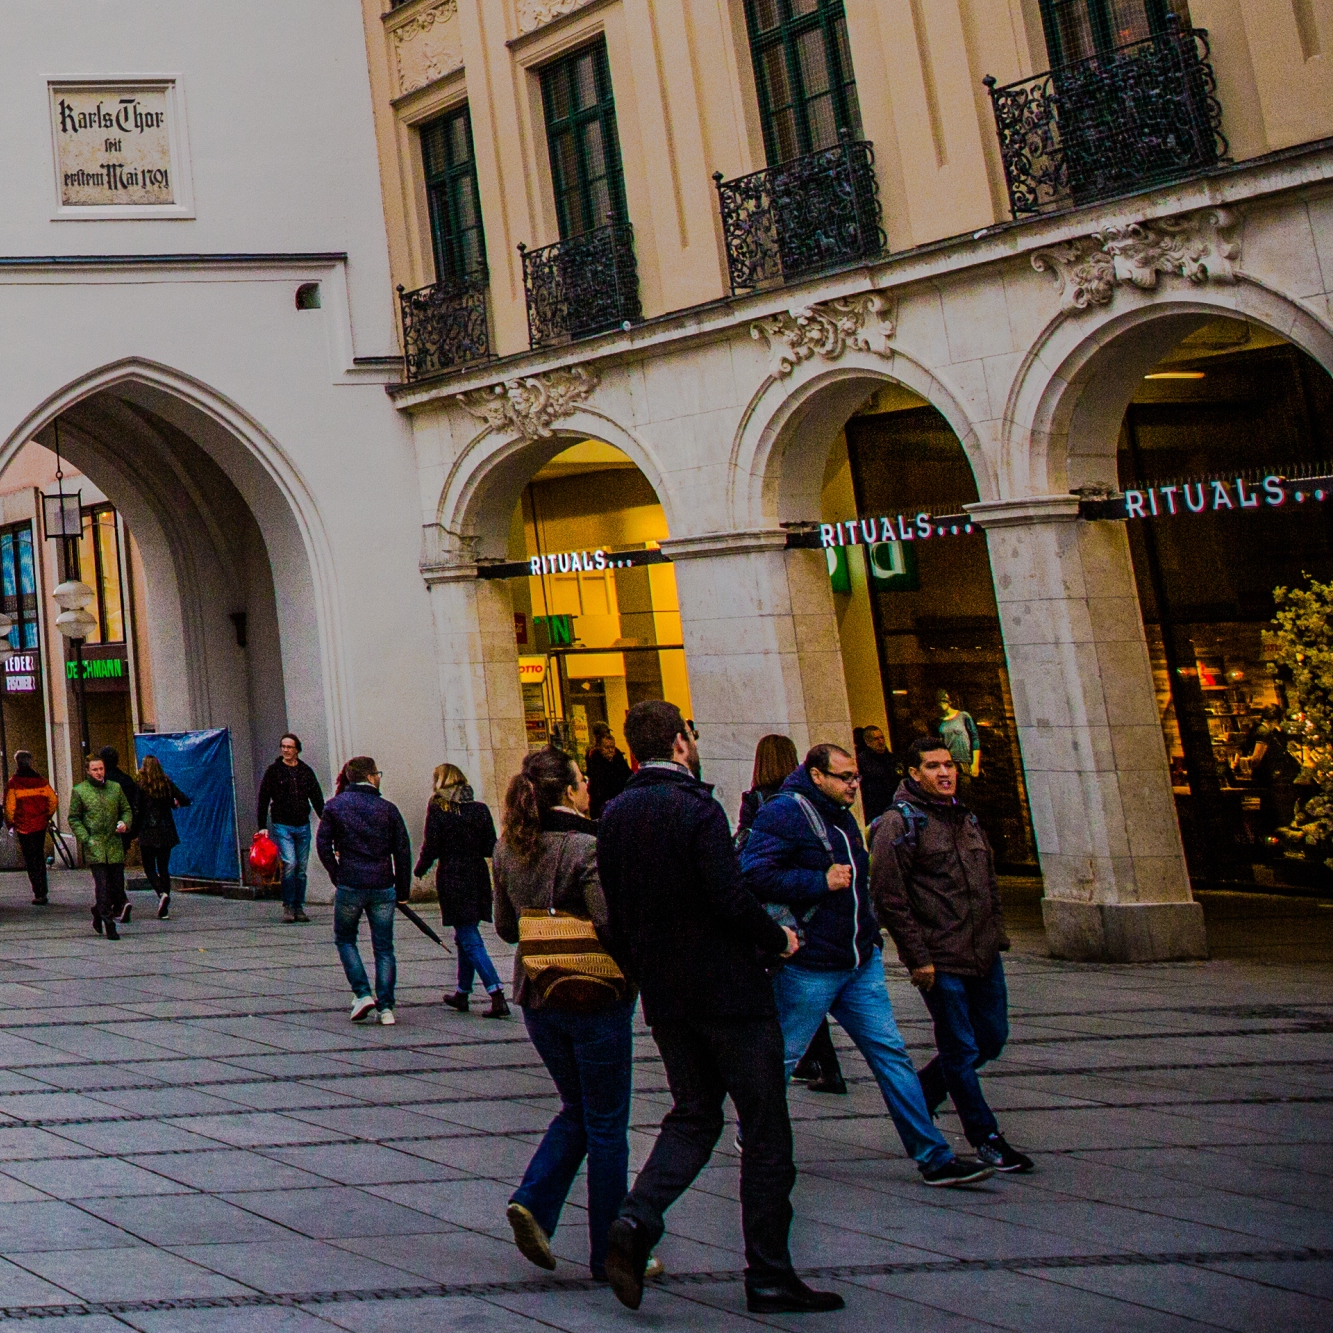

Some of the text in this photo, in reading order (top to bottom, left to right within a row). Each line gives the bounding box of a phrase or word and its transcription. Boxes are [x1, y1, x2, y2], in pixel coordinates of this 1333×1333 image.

[59, 99, 164, 134] Karls Thor
[99, 163, 139, 190] Mai
[67, 659, 121, 679] DECHMANN
[519, 665, 543, 673] OTTO
